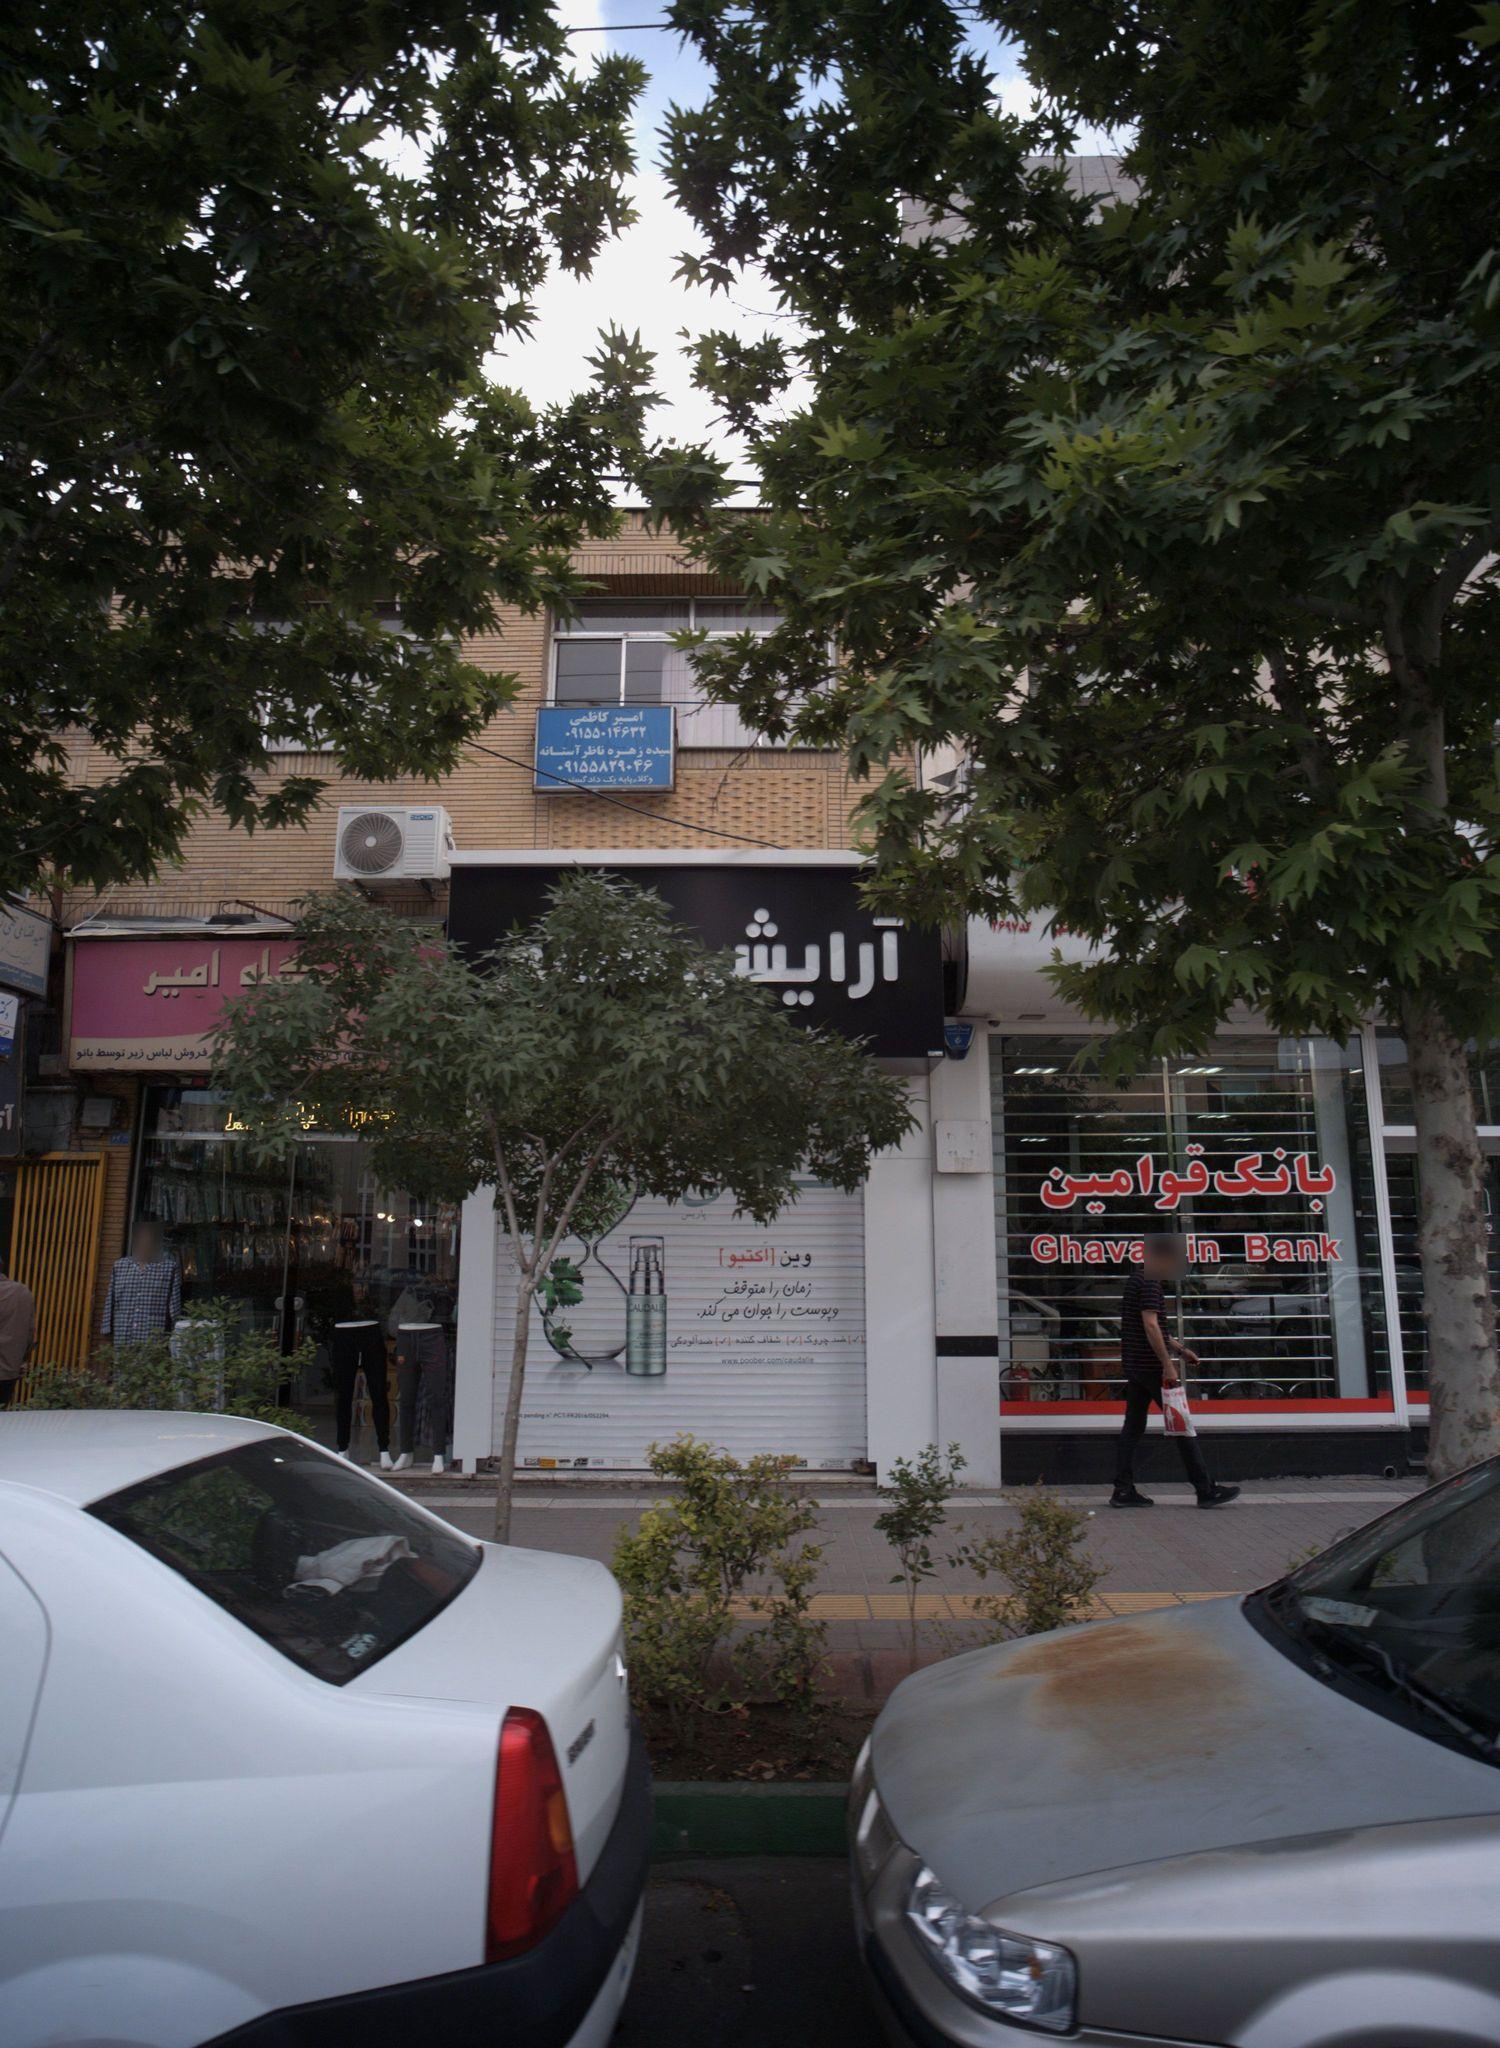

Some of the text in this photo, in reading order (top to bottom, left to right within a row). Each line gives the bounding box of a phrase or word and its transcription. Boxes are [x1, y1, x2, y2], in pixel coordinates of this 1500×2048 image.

[569, 711, 643, 726] امیر کاظمی
[143, 947, 221, 998] امیر
[76, 1047, 208, 1061] فروش لباس زیر توسط بانو
[1040, 1143, 1336, 1213] بانک قوامین
[1031, 1233, 1343, 1264] Ghavain Bank
[780, 1250, 812, 1268] وین
[723, 1280, 812, 1300] زمان را متوقف
[743, 1303, 773, 1319] جوان
[776, 1302, 786, 1319] را
